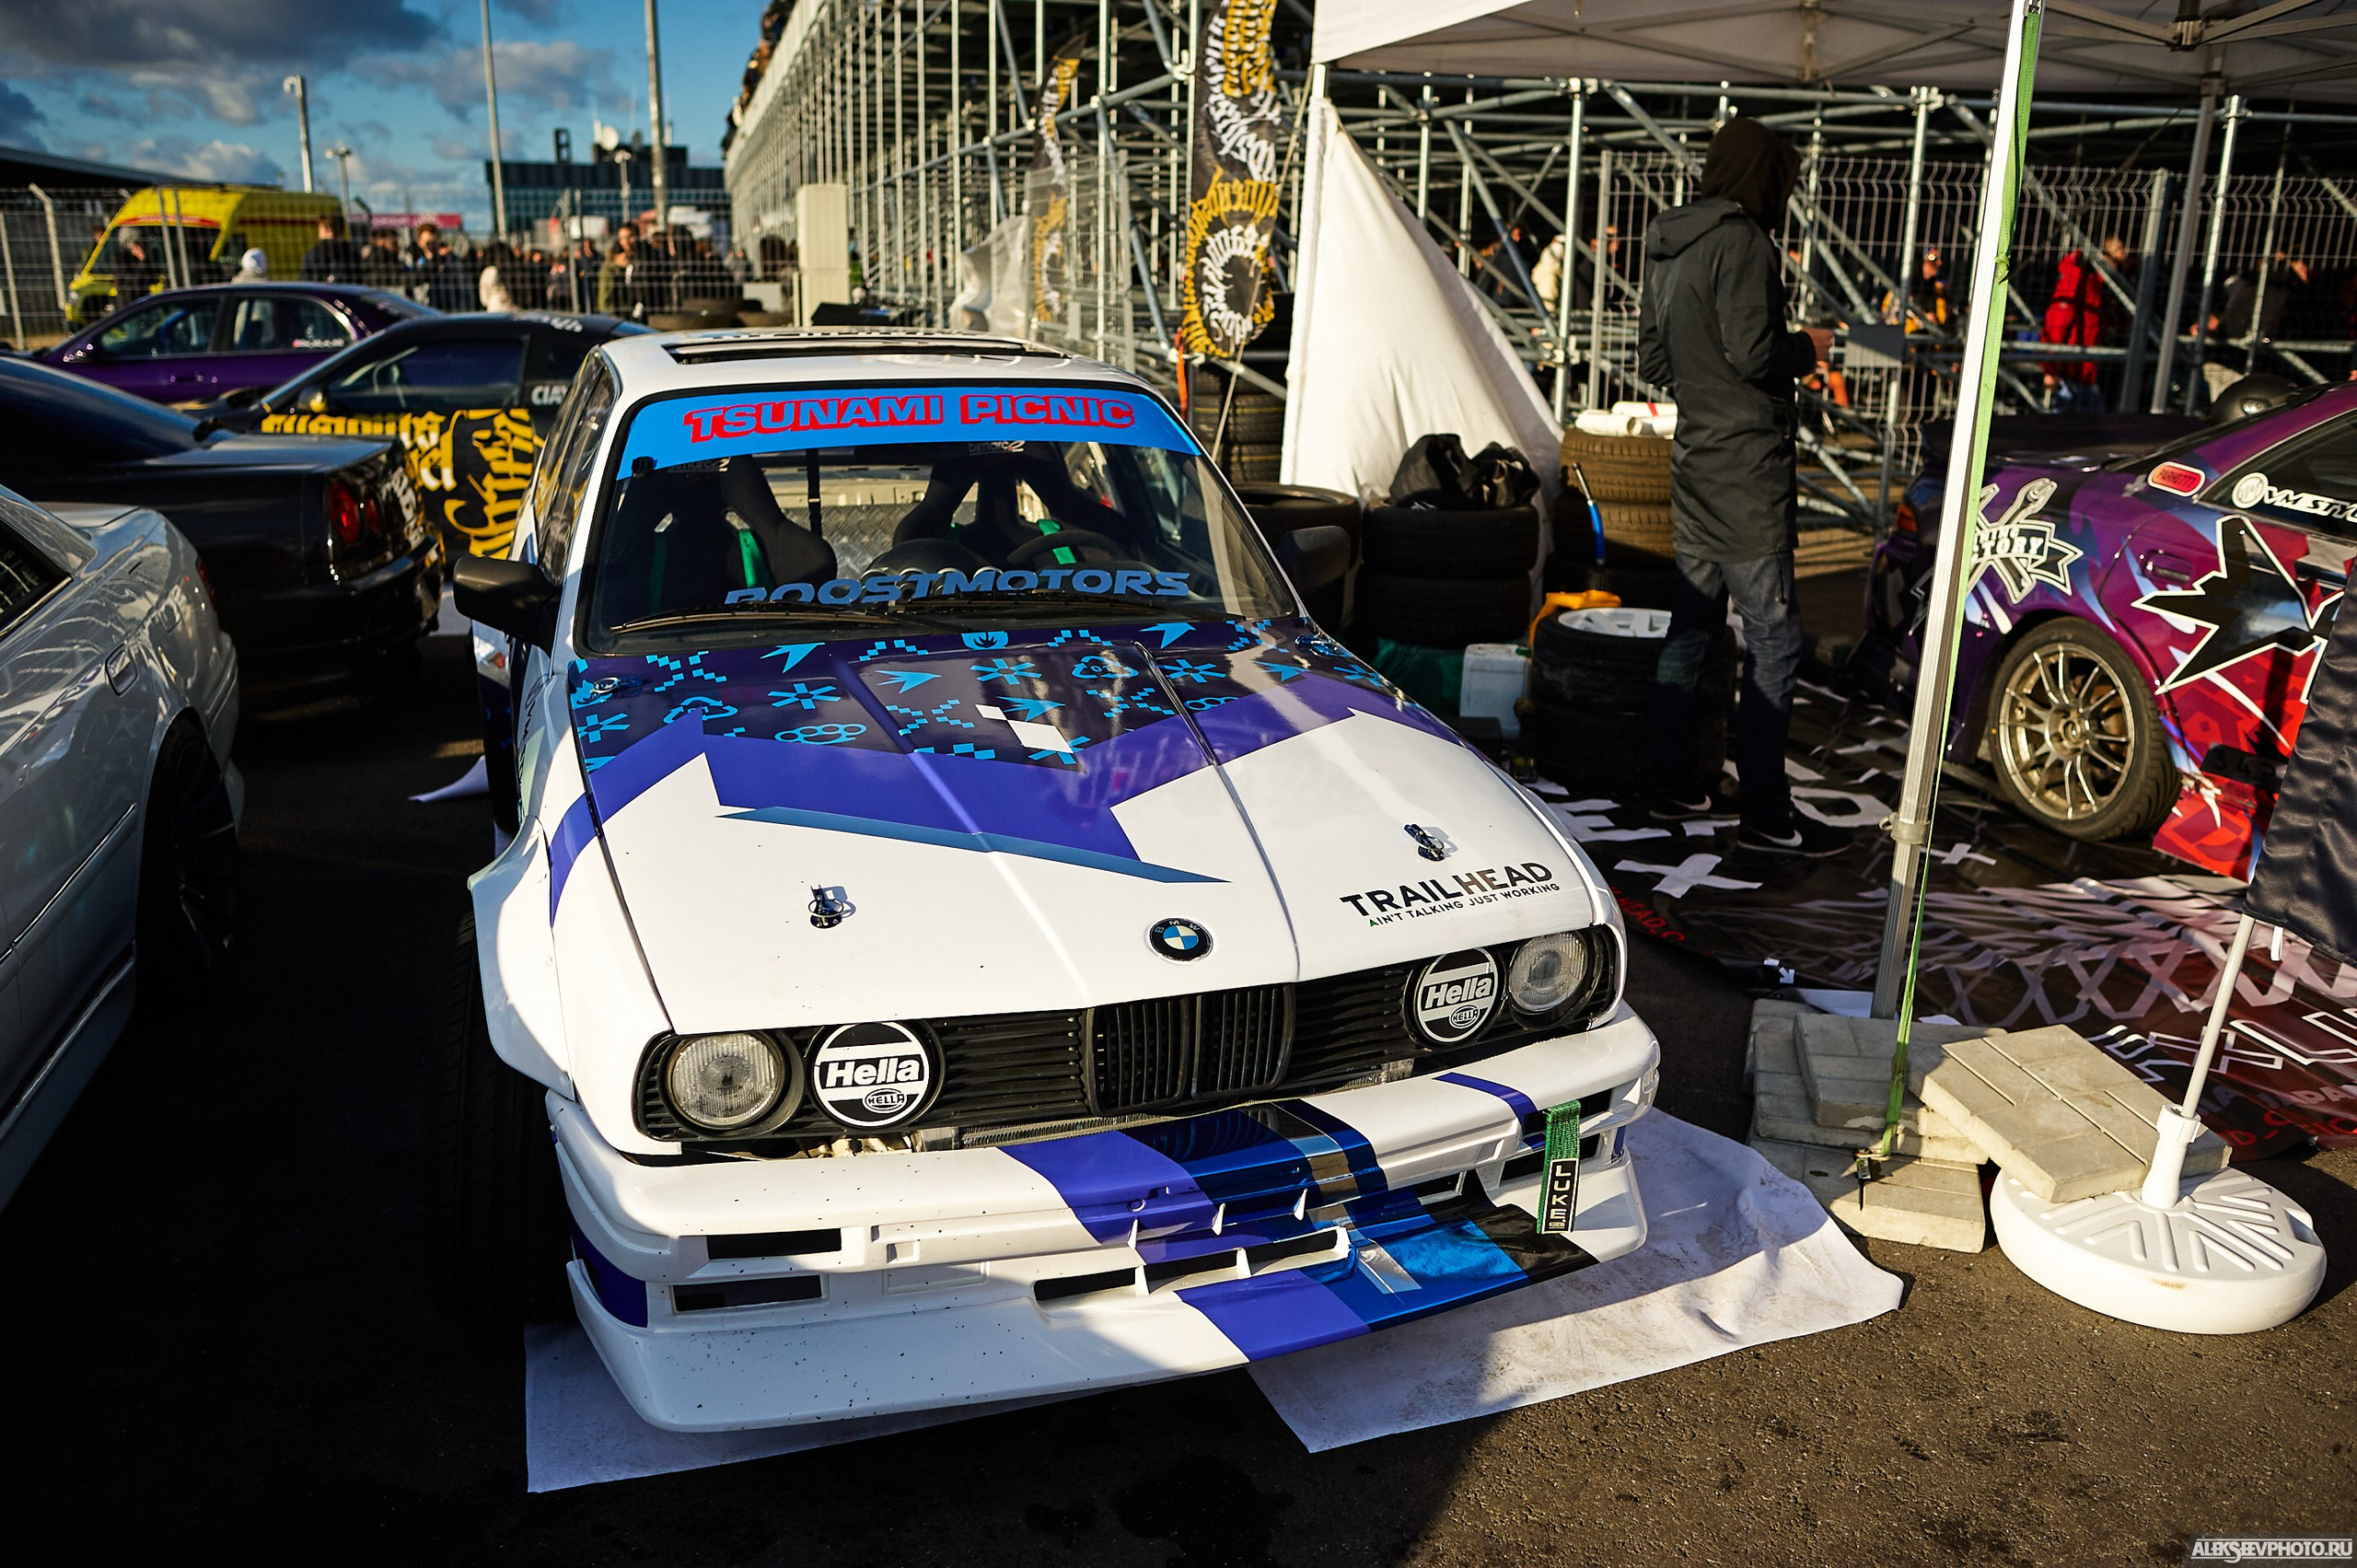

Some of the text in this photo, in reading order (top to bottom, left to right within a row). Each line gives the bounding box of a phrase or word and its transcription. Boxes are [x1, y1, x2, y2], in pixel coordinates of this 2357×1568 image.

[683, 394, 1135, 443] TSUNAMI PICNIC
[1339, 862, 1553, 917] TRAILHEAD
[1369, 882, 1561, 927] AIN'T TALKING JUST WORKING
[1155, 920, 1201, 934] BMW
[1424, 977, 1492, 1009] Hella
[825, 1057, 921, 1087] Hella
[867, 1094, 905, 1105] HELLA
